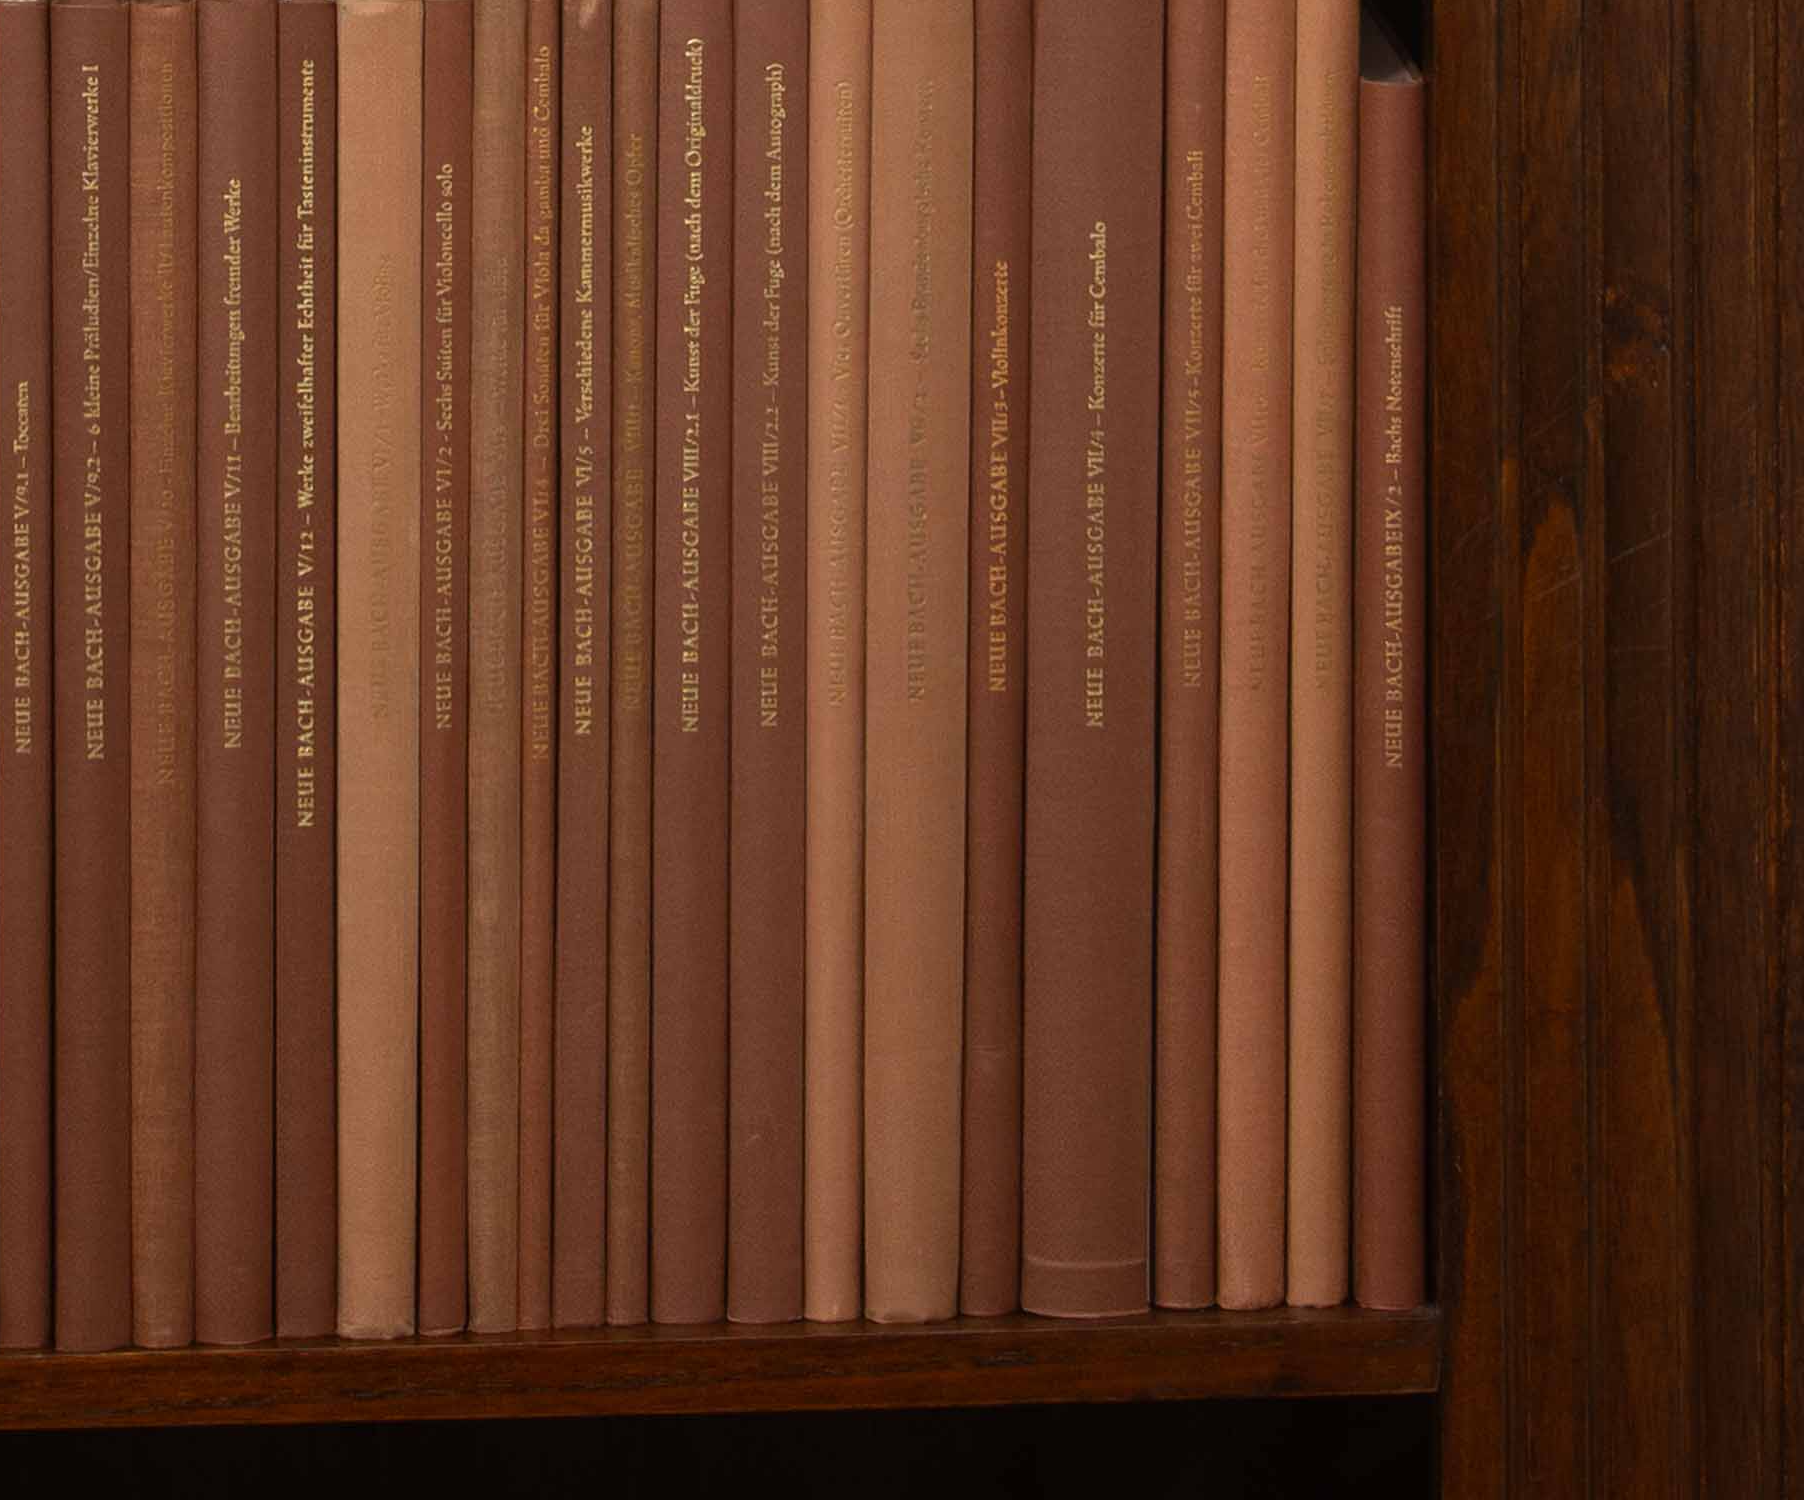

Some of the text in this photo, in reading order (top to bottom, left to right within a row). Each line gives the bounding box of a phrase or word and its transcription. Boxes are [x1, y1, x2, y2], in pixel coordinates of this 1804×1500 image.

[81, 63, 99, 72] I
[683, 37, 706, 167] Originaldruck)
[80, 75, 99, 191] Klavierwerke
[683, 171, 702, 209] dem
[683, 212, 704, 261] (nach
[1088, 220, 1107, 299] Cembalo
[81, 194, 100, 360] Präludien/Einzelne
[683, 265, 705, 305] Fuge
[682, 307, 700, 338] der
[1087, 300, 1106, 328] für
[82, 364, 101, 418] kleine
[683, 339, 700, 392] Kunst
[1087, 331, 1105, 410] Konzerte
[12, 379, 30, 454] Toccaten
[296, 58, 314, 827] NEUE BACH-AUSGABE V/12 Werke zweifelhafter Echtheit für Tasteninstrumente
[574, 124, 593, 734] NEUE BACH-AUSGABE VI/5 Verschiedene Kammermusikwerke
[83, 456, 101, 508] V/9.2
[83, 511, 104, 689] BACH-AUSGABE
[681, 486, 699, 663] BACH-AUSGABE
[1086, 482, 1105, 657] BACH-AUSGABE
[13, 522, 30, 688] BACH-AUSGABE
[14, 696, 31, 753] NEUE
[681, 671, 699, 732] NEUE
[1085, 667, 1104, 727] NEUE
[85, 698, 104, 759] NEUE
